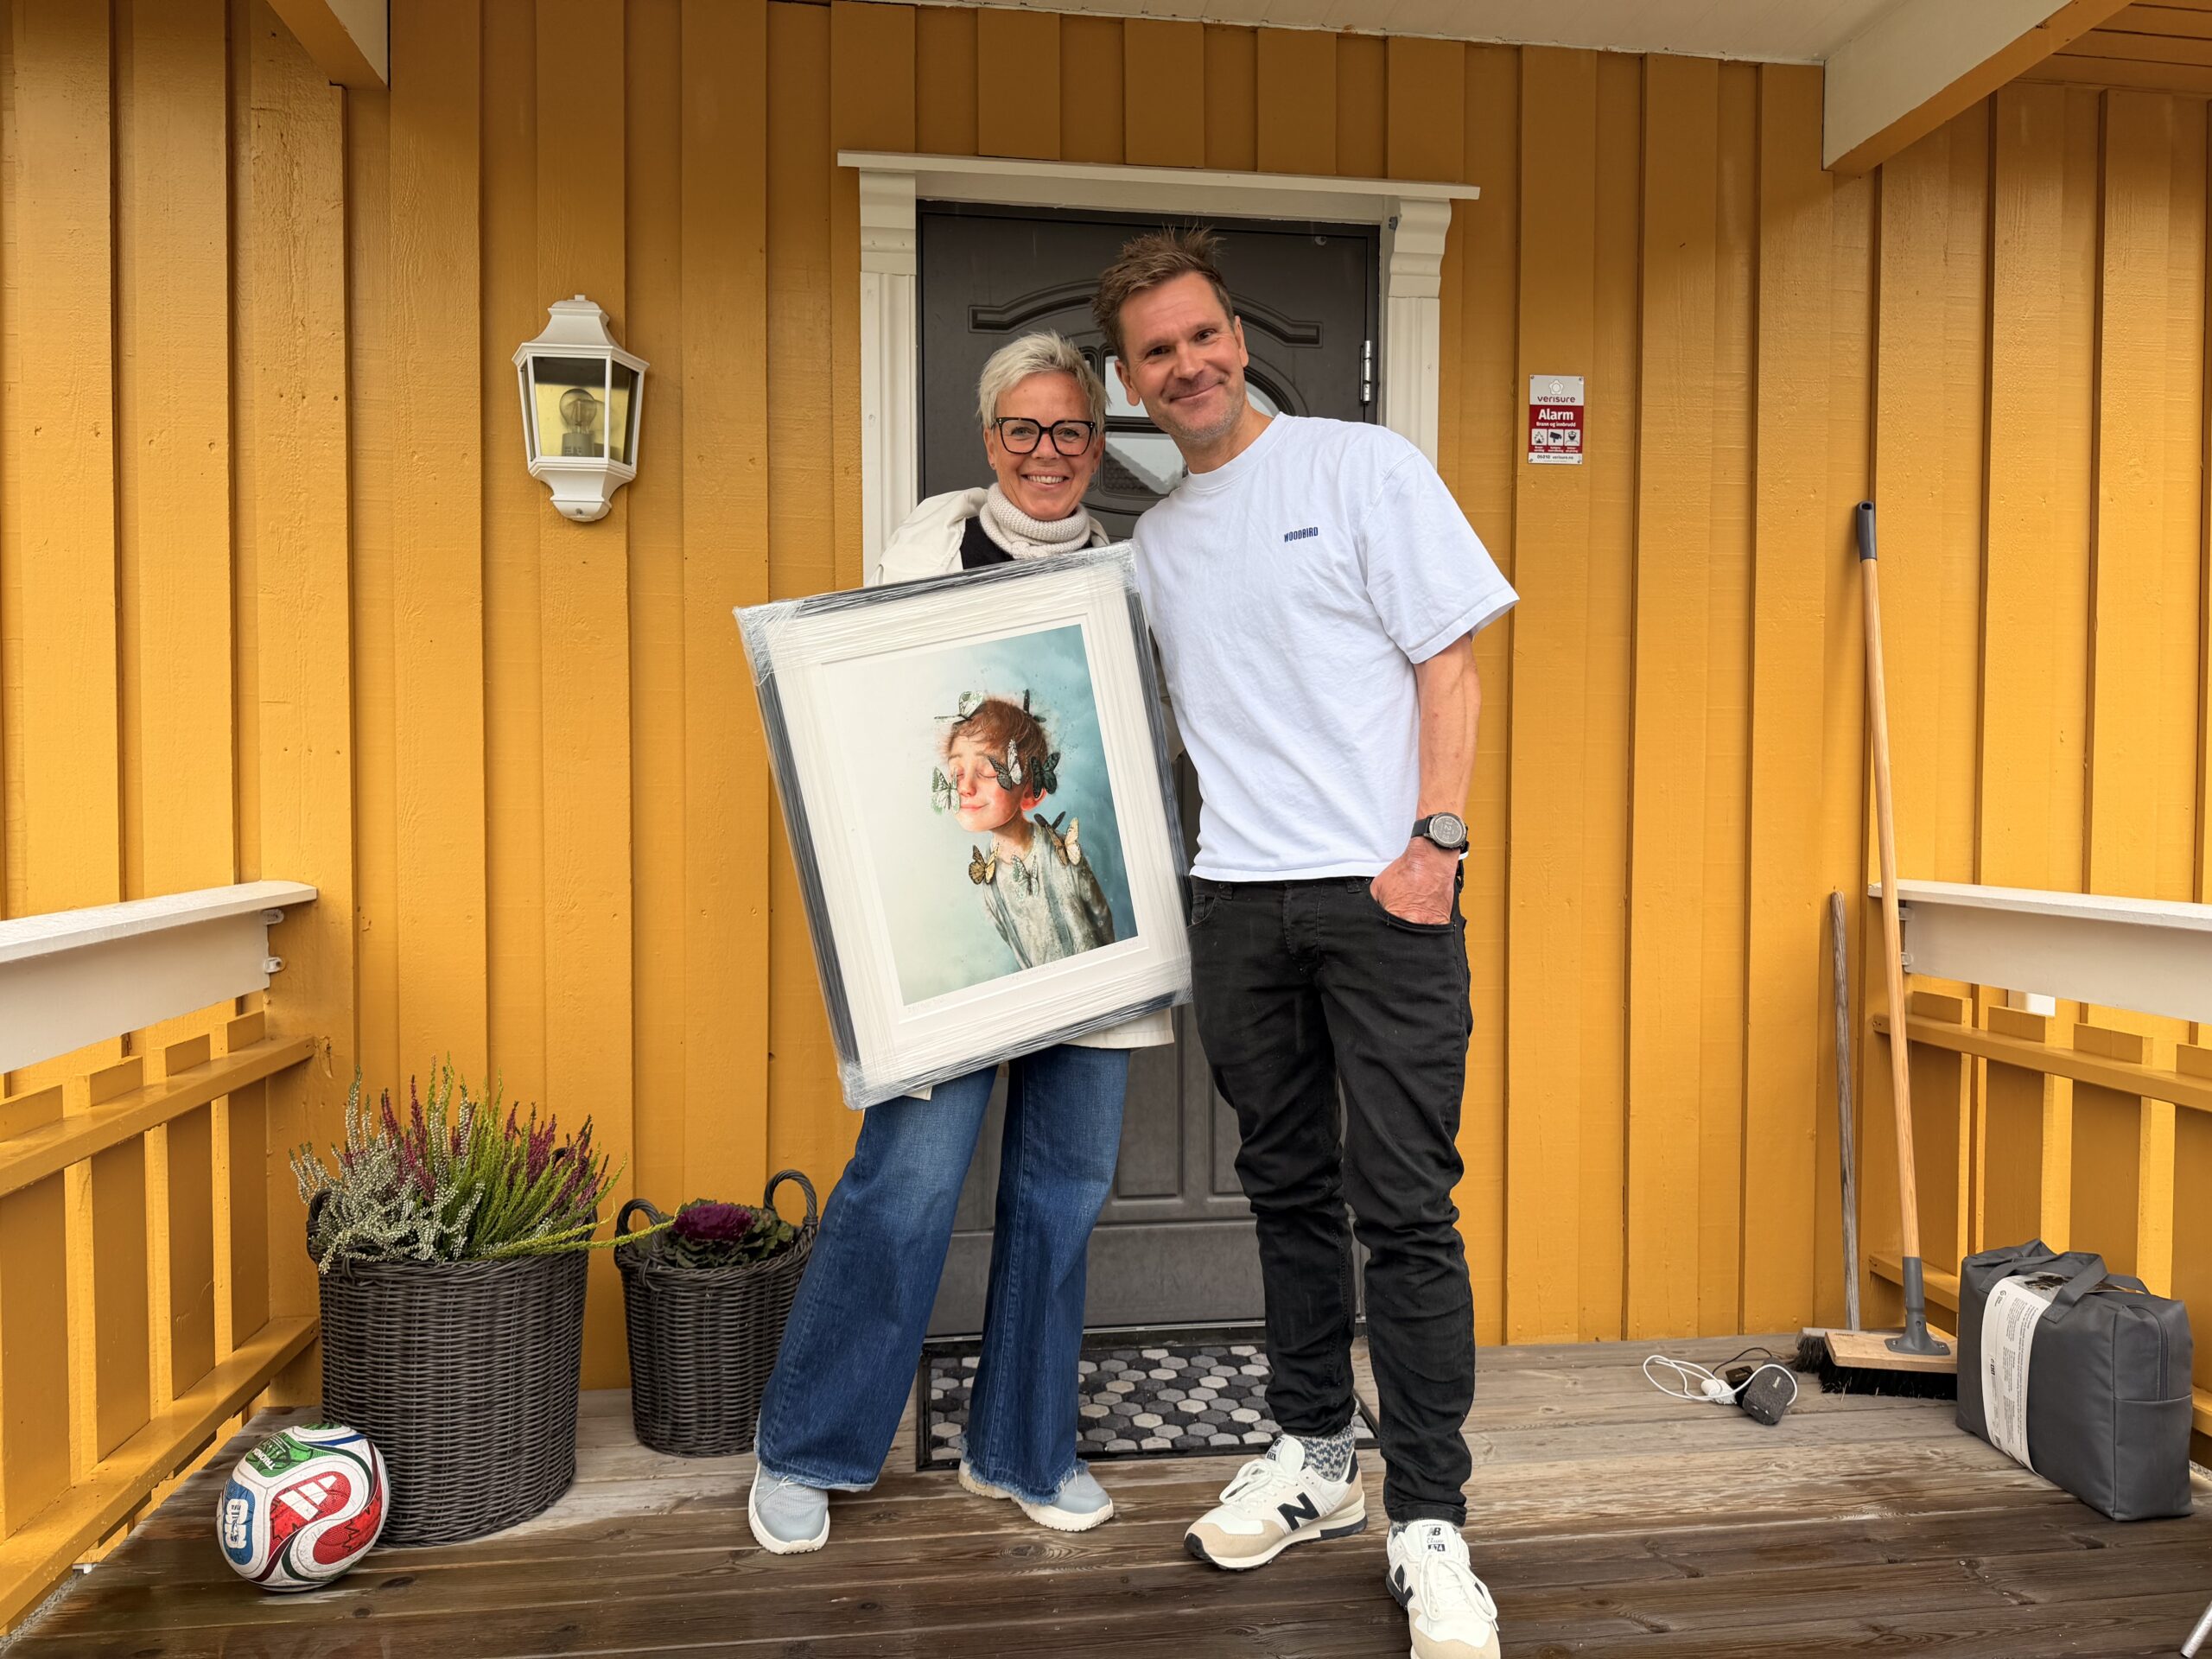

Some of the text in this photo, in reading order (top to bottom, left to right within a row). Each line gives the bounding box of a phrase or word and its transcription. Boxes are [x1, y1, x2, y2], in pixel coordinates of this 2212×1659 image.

[1538, 408, 1573, 420] Alarm
[1284, 526, 1319, 543] WOODBIRD
[1277, 1491, 1321, 1532] N
